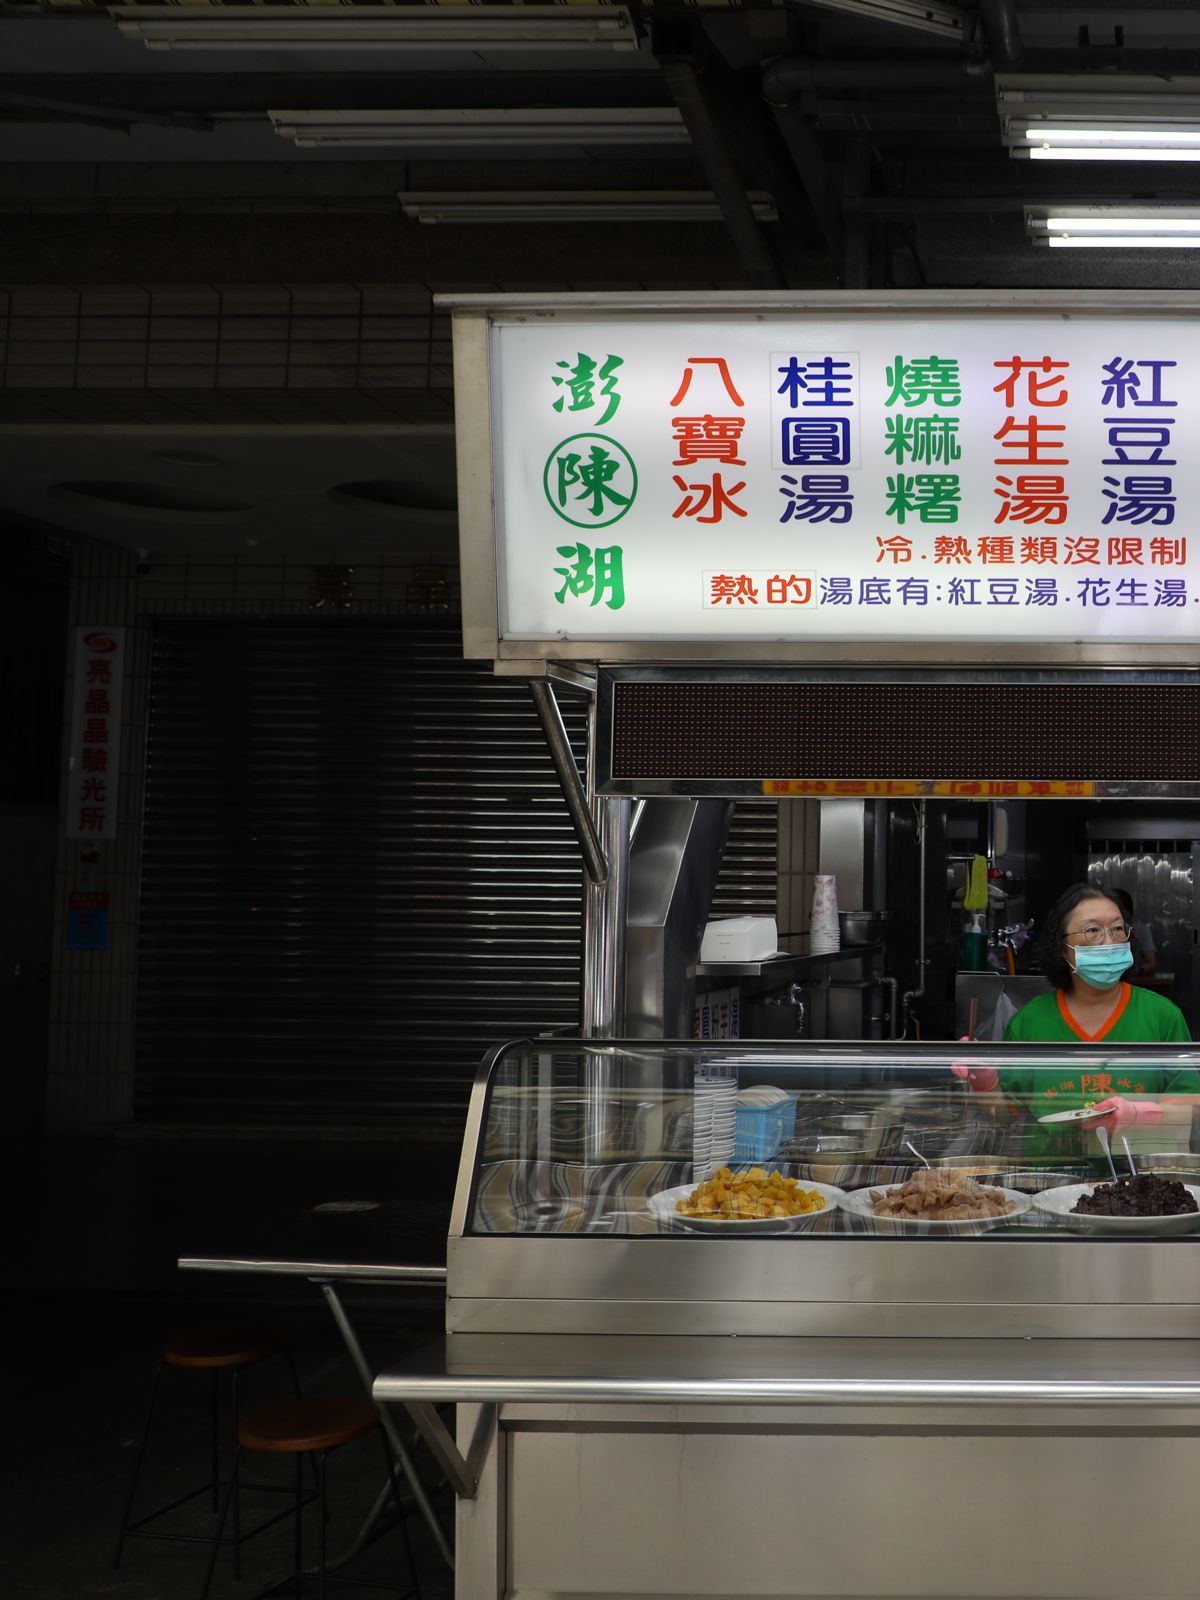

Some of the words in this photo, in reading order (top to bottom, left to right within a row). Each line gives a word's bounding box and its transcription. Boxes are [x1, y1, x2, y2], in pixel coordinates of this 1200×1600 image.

[669, 356, 748, 524] 八寶冰
[778, 356, 854, 524] 桂圓湯
[993, 355, 1070, 525] 花生湯
[1101, 356, 1178, 526] 紅豆湯
[79, 660, 111, 832] 亮晶晶驗光所
